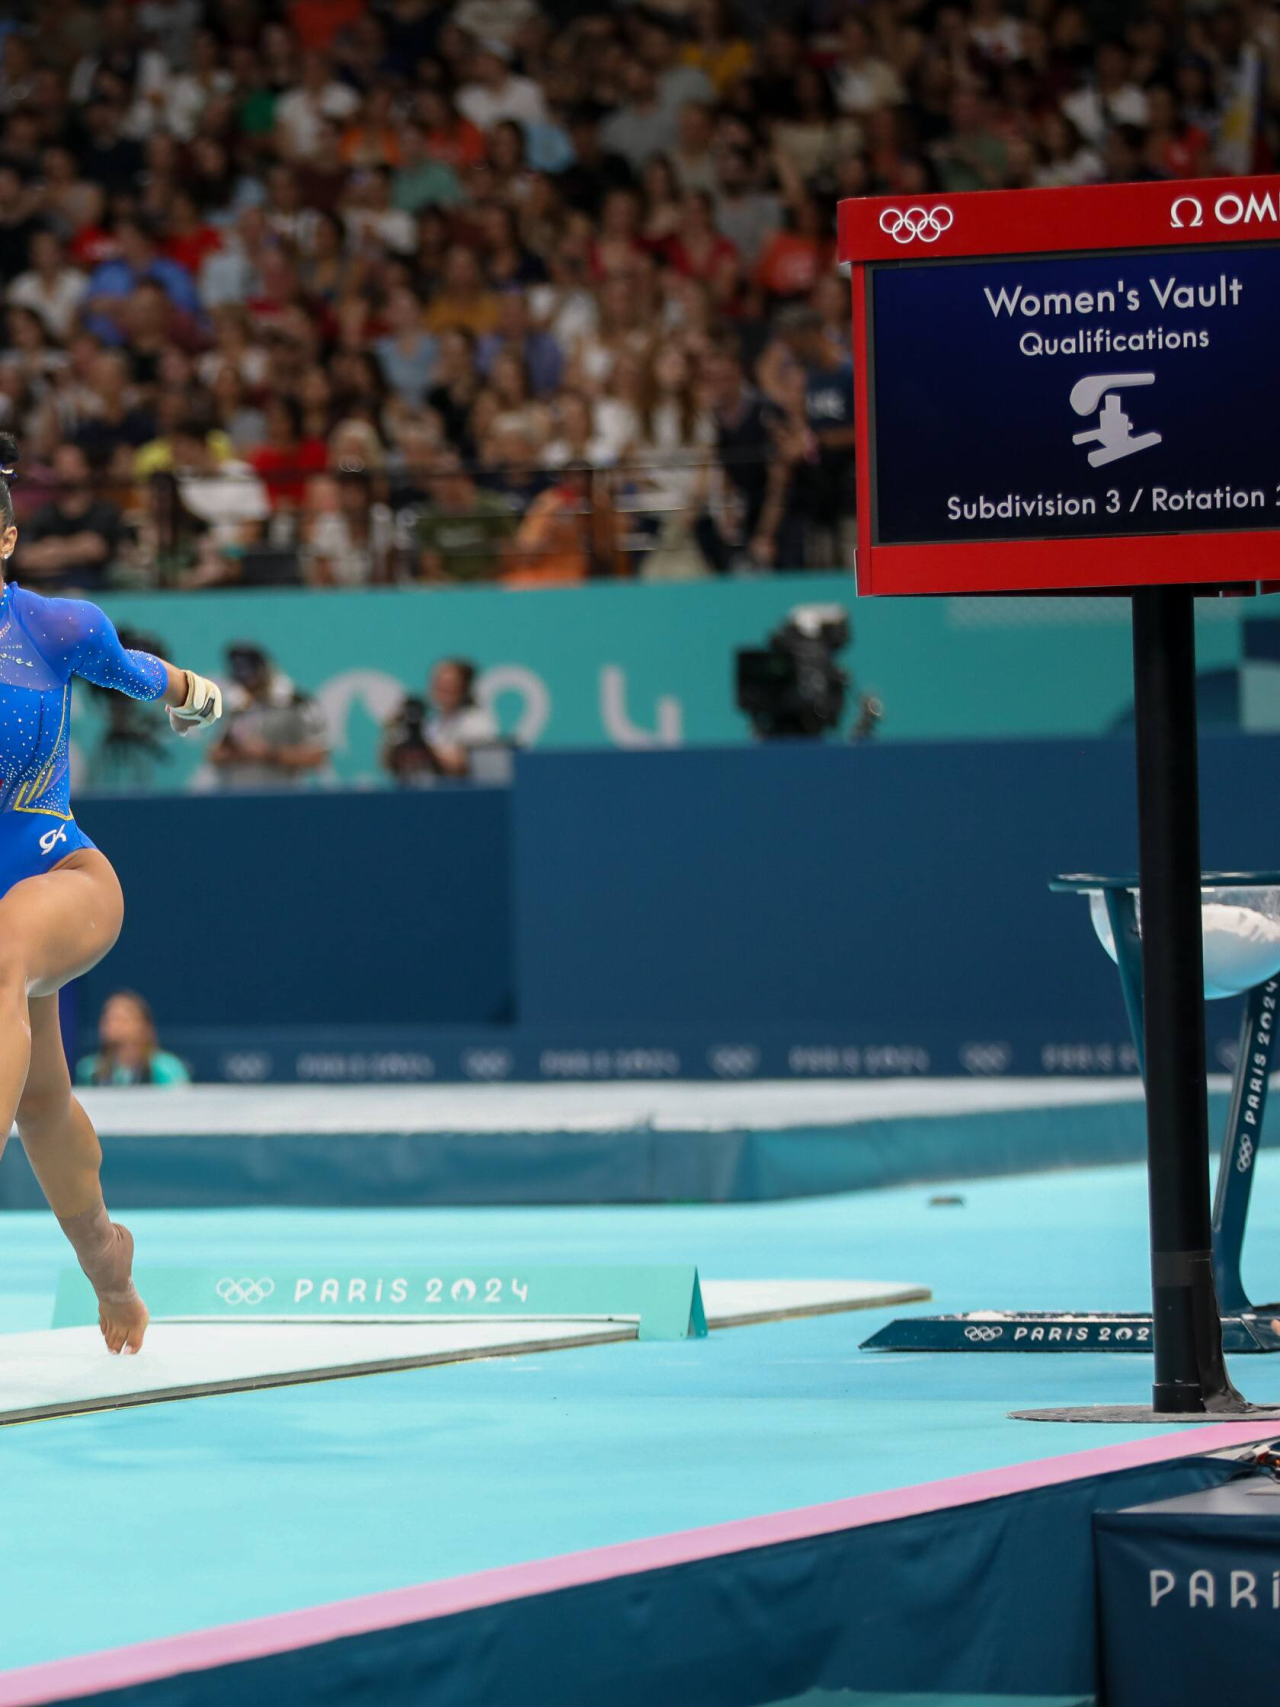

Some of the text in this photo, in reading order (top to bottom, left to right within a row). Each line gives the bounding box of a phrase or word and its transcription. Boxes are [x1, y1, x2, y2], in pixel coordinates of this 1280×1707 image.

[1214, 190, 1280, 225] OM
[984, 273, 1243, 318] Women's Vault
[1019, 327, 1210, 356] Qualifications
[947, 492, 1096, 520] Subdivision
[1106, 489, 1120, 513] 3
[1128, 488, 1143, 513] /
[1152, 484, 1266, 511] Rotation
[1257, 980, 1278, 1047] 2024
[425, 1278, 528, 1304] 2024
[1098, 1327, 1150, 1342] 202
